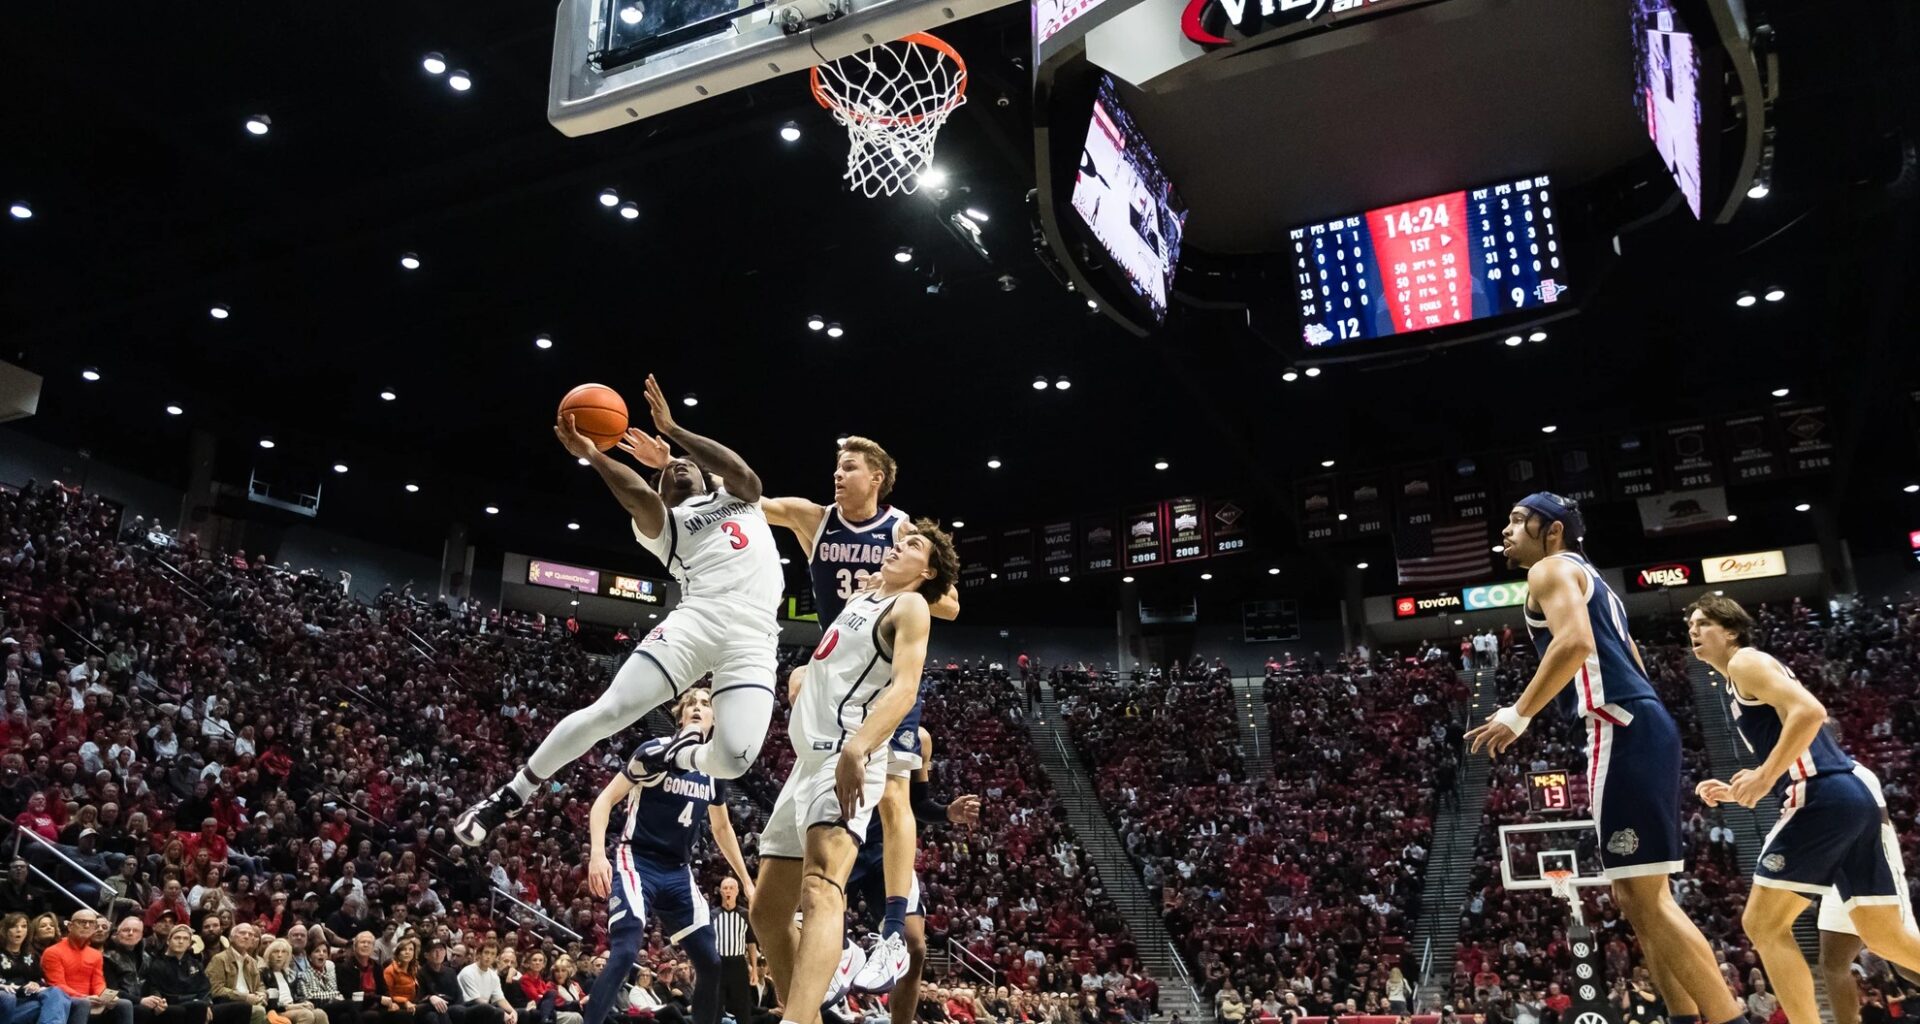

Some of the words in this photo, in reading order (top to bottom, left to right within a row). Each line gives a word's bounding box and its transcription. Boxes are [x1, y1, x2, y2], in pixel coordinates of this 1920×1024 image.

[1473, 189, 1488, 200] PLY
[1495, 184, 1511, 195] PTS
[1515, 180, 1532, 191] REB
[1535, 176, 1550, 187] FLS
[1479, 203, 1487, 215] 2
[1501, 198, 1509, 210] 3
[1522, 194, 1530, 206] 2
[1540, 191, 1548, 202] 0
[1290, 229, 1303, 239] PLY
[1311, 224, 1325, 235] PTS
[1329, 220, 1344, 231] REB
[1347, 217, 1360, 227] FLS
[1384, 203, 1450, 238] 14:24
[1482, 220, 1490, 231] 3
[1504, 215, 1512, 226] 3
[1525, 210, 1533, 221] 0
[1543, 207, 1551, 218] 0
[1296, 242, 1302, 253] 0
[1316, 238, 1323, 248] 3
[1336, 234, 1342, 244] 1
[1353, 231, 1358, 241] 1
[1410, 237, 1430, 253] 1ST
[1482, 235, 1495, 248] 21
[1506, 231, 1514, 243] 0
[1528, 227, 1536, 238] 3
[1547, 223, 1553, 235] 1
[1298, 258, 1305, 268] 4
[1318, 254, 1325, 264] 0
[1337, 250, 1344, 260] 0
[1354, 247, 1361, 257] 0
[1486, 251, 1498, 264] 31
[1509, 247, 1517, 259] 3
[1530, 243, 1538, 255] 0
[1548, 240, 1556, 252] 0
[1299, 273, 1310, 284] 11
[1320, 269, 1327, 280] 0
[1341, 265, 1346, 276] 1
[1356, 263, 1363, 273] 0
[1394, 262, 1407, 275] 50
[1442, 253, 1455, 265] 50
[1488, 268, 1501, 280] 40
[1512, 264, 1520, 276] 0
[1533, 260, 1541, 272] 0
[1551, 257, 1559, 268] 0
[1301, 289, 1313, 300] 33
[1322, 285, 1329, 296] 0
[1342, 281, 1349, 292] 0
[1358, 279, 1366, 289] 0
[1396, 276, 1409, 289] 50
[1398, 290, 1411, 303] 67
[1449, 281, 1456, 293] 0
[1303, 304, 1315, 316] 34
[1325, 301, 1332, 312] 5
[1344, 297, 1351, 308] 0
[1361, 295, 1368, 305] 0
[1404, 304, 1410, 315] 5
[1419, 300, 1442, 312] FOULS
[1451, 295, 1458, 307] 2
[1511, 287, 1525, 307] 9
[1337, 318, 1360, 339] 12
[1405, 318, 1412, 329] 4
[1453, 309, 1460, 320] 4
[1681, 474, 1711, 486] 2015
[1740, 466, 1771, 478] 2016
[1625, 483, 1652, 494] 2014
[684, 516, 704, 535] SAN
[702, 507, 731, 525] DIEGO
[1409, 514, 1431, 524] 2011
[1461, 506, 1483, 517] 2011
[721, 522, 749, 550] 3
[1308, 528, 1332, 539] 2010
[1359, 522, 1380, 532] 2011
[1045, 534, 1071, 544] WAC
[1219, 540, 1244, 550] 2009
[1132, 553, 1156, 564] 2006
[1176, 546, 1200, 557] 2006
[618, 577, 638, 591] FOX
[1641, 567, 1685, 586] VIEJAS
[622, 589, 635, 599] San
[636, 592, 657, 602] Diego
[1417, 596, 1460, 610] TOYOTA
[1468, 583, 1529, 608] COX
[663, 776, 711, 801] GONZAGA
[1535, 774, 1566, 787] 14:24
[1544, 786, 1565, 807] 13
[677, 801, 694, 828] 4
